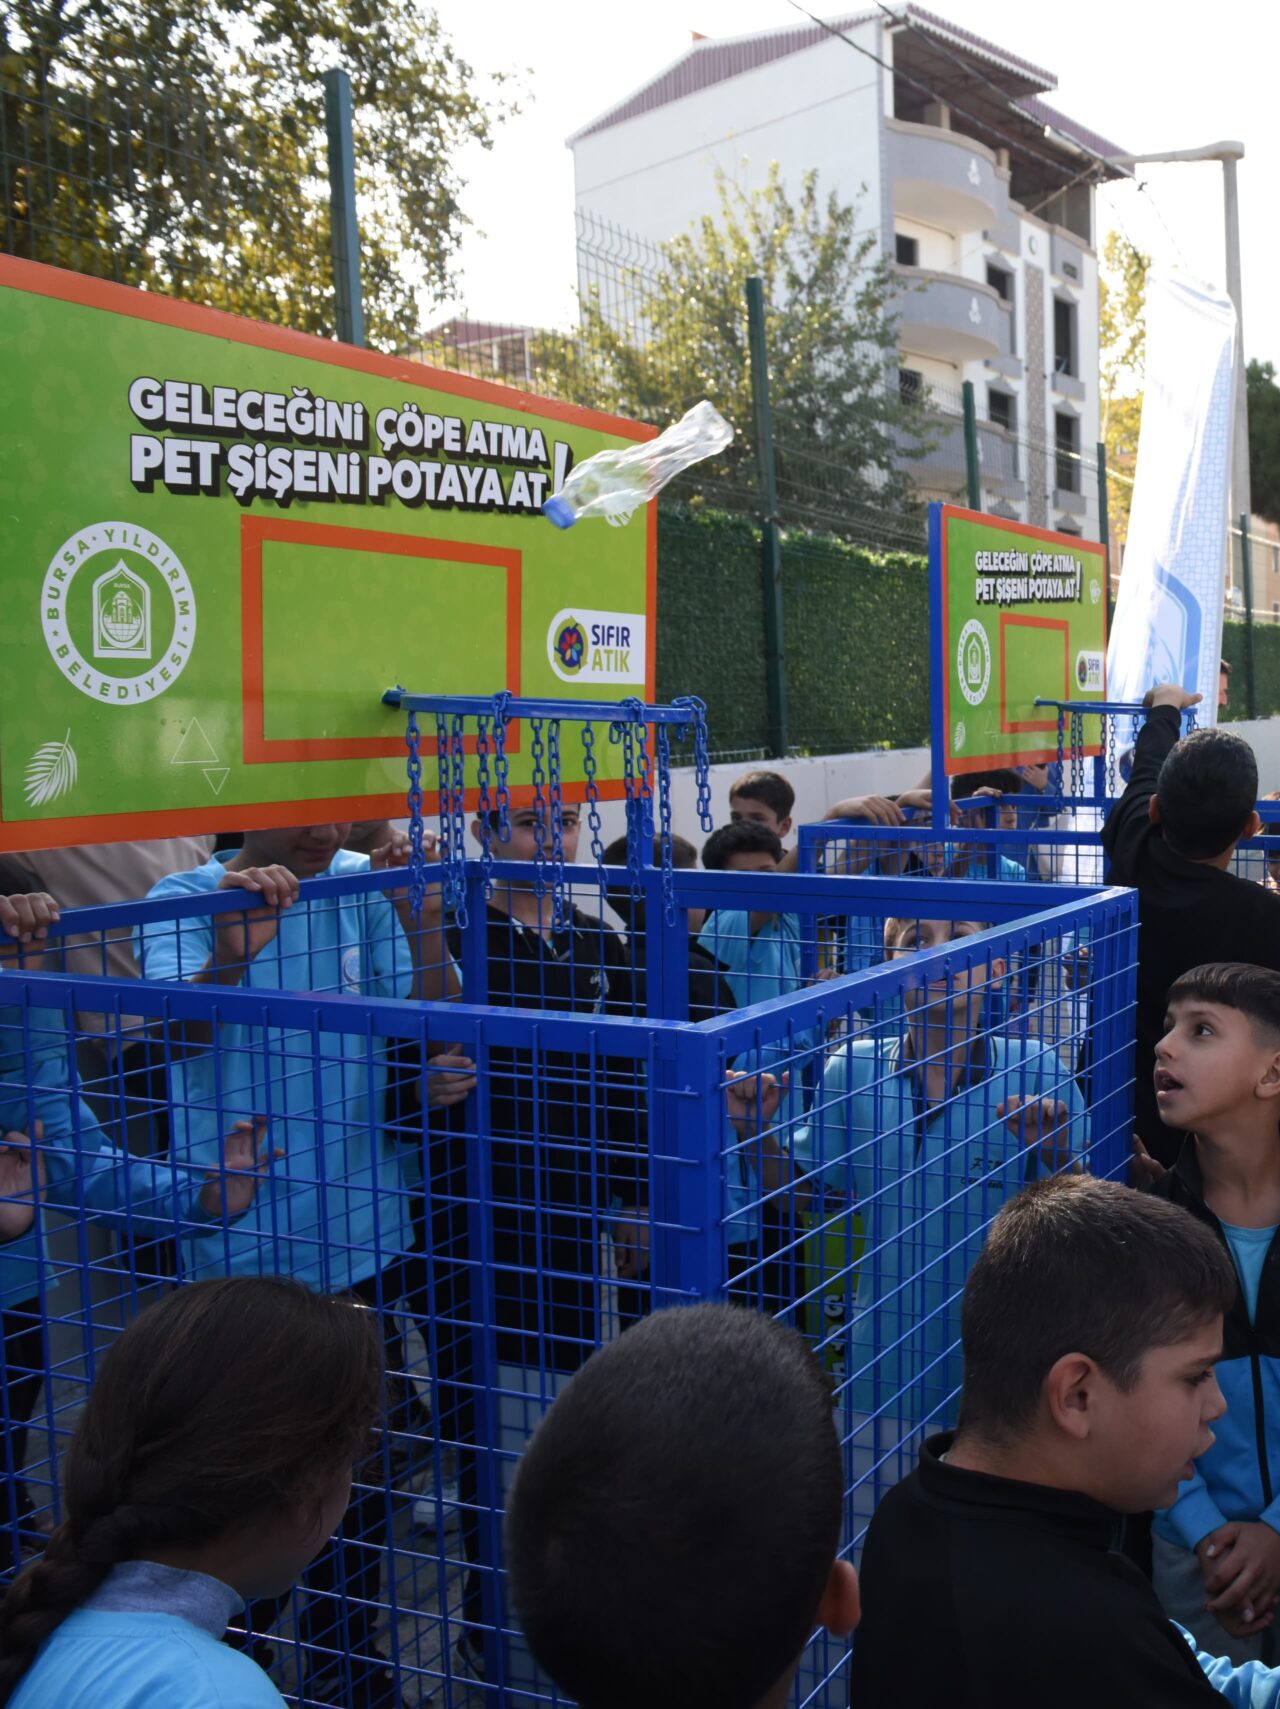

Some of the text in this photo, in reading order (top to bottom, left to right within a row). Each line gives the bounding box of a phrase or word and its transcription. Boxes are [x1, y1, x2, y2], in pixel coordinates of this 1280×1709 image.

[375, 401, 462, 453] ÇÖPE
[466, 420, 548, 463] ATMA
[130, 433, 221, 490] PET
[368, 456, 504, 506] POTAYA
[47, 528, 191, 620] BURSA YILDIRIM
[1030, 550, 1053, 575] ÇÖPE
[1053, 554, 1075, 573] ATMA
[975, 577, 995, 601] PET
[1029, 578, 1063, 599] POTAYA
[591, 623, 631, 648] SIFIR
[591, 648, 631, 673] ATIK
